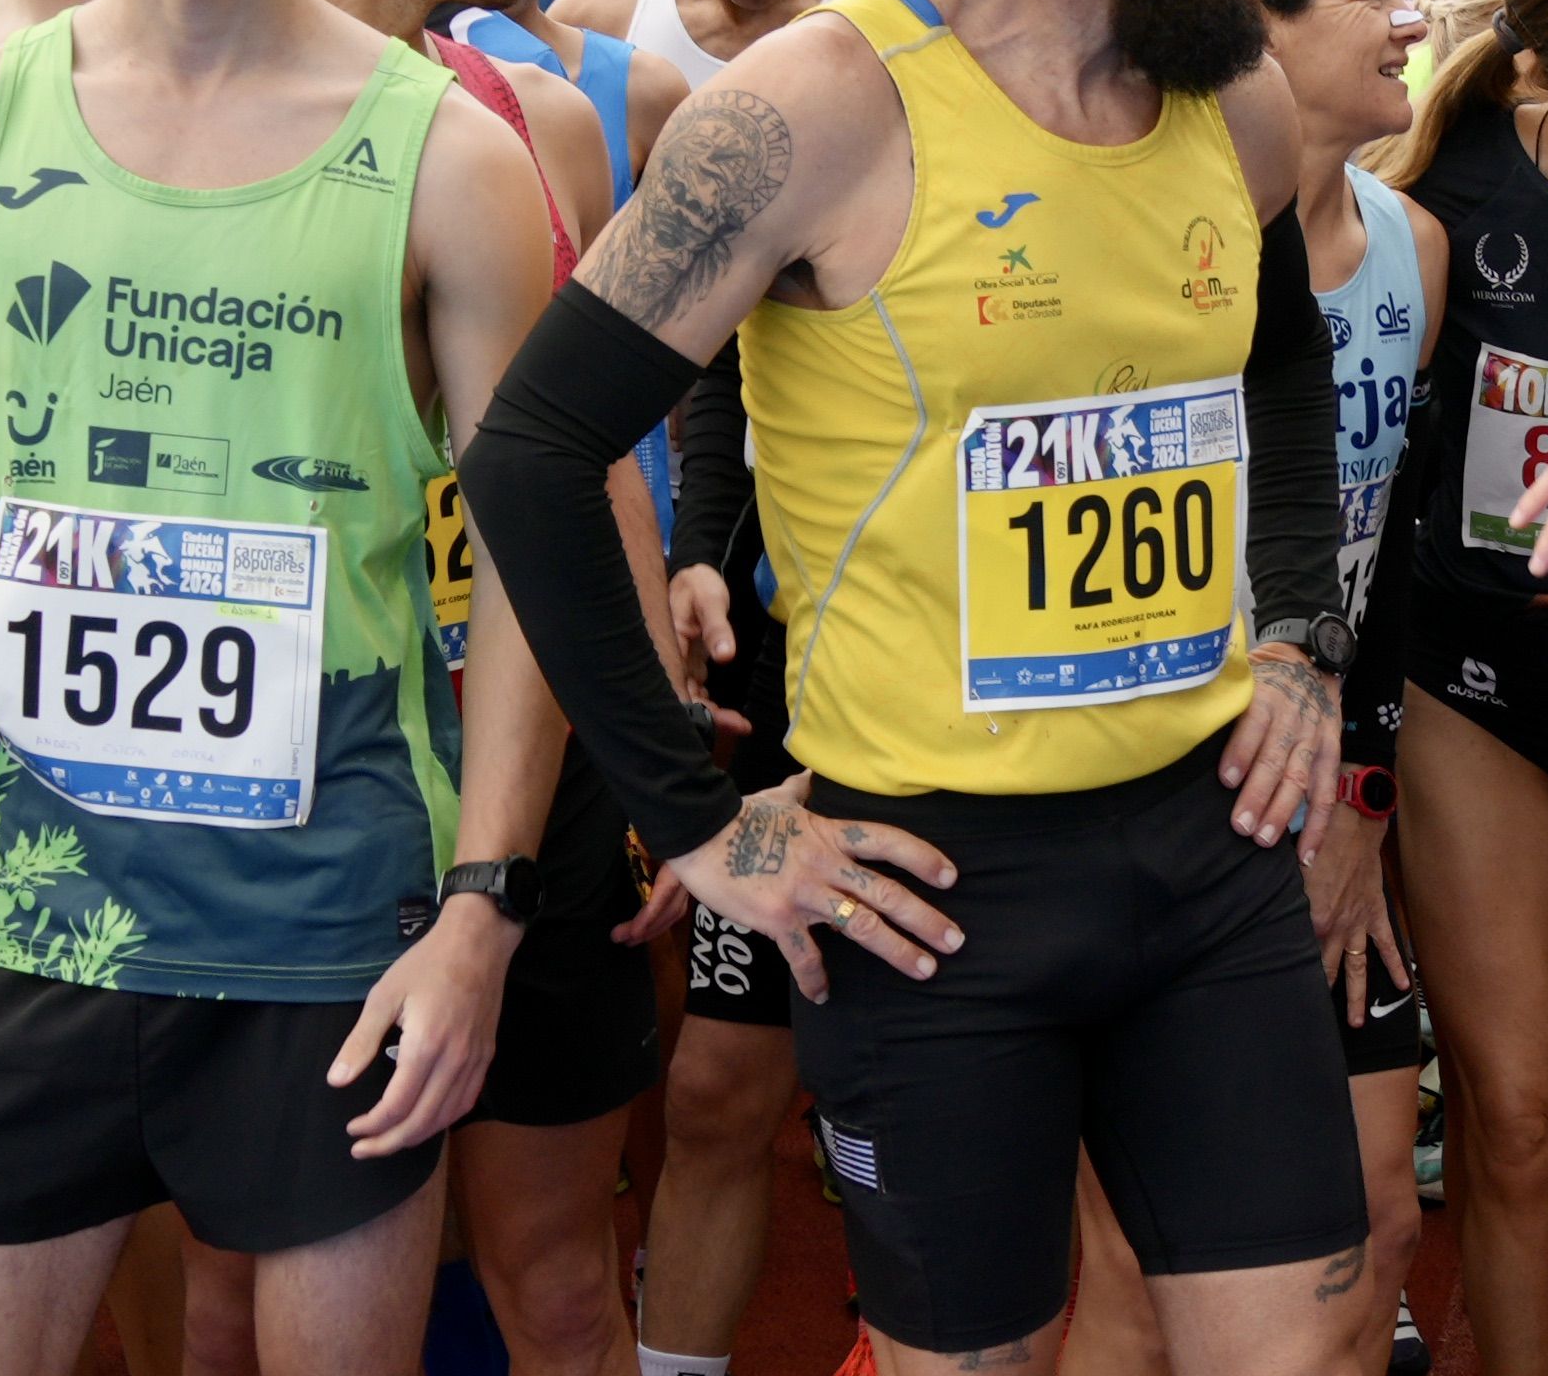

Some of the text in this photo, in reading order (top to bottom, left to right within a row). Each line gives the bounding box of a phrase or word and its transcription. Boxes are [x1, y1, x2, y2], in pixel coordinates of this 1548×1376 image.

[107, 275, 345, 341] Fundación
[1012, 298, 1062, 310] Diputación
[1472, 290, 1535, 304] HERMES GYM
[103, 318, 274, 381] Unicaja
[99, 372, 173, 406] Jaén
[1335, 357, 1408, 450] rja
[1149, 416, 1182, 434] LUCENA
[1006, 412, 1104, 488] 21K
[1151, 441, 1186, 468] 2026
[14, 510, 117, 591] 21K
[181, 542, 225, 559] LUCENA
[233, 545, 294, 562] carreras
[1008, 479, 1213, 611] 1260
[232, 558, 306, 576] populares
[179, 573, 224, 597] 2026
[1074, 607, 1177, 632] RAFA RODRÍGUEZ DURÁN
[1107, 635, 1129, 644] TALLA
[7, 610, 257, 739] 1529
